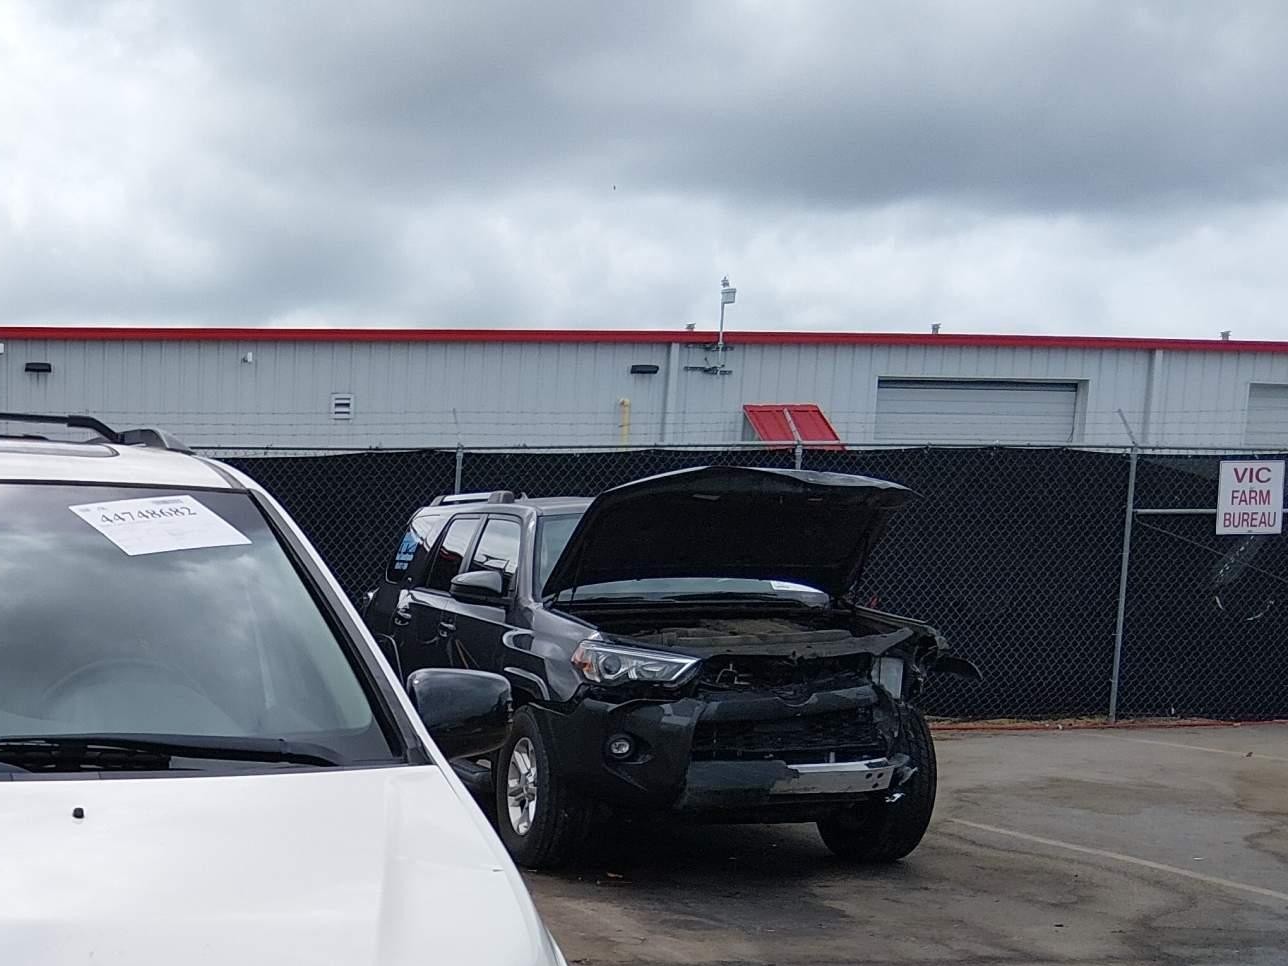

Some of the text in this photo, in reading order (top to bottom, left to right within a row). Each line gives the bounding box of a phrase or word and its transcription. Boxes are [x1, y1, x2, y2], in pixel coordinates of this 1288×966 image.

[1233, 467, 1272, 483] VIC
[1231, 489, 1271, 506] FARM
[101, 506, 196, 523] 44748682
[1223, 511, 1277, 528] BUREAU
